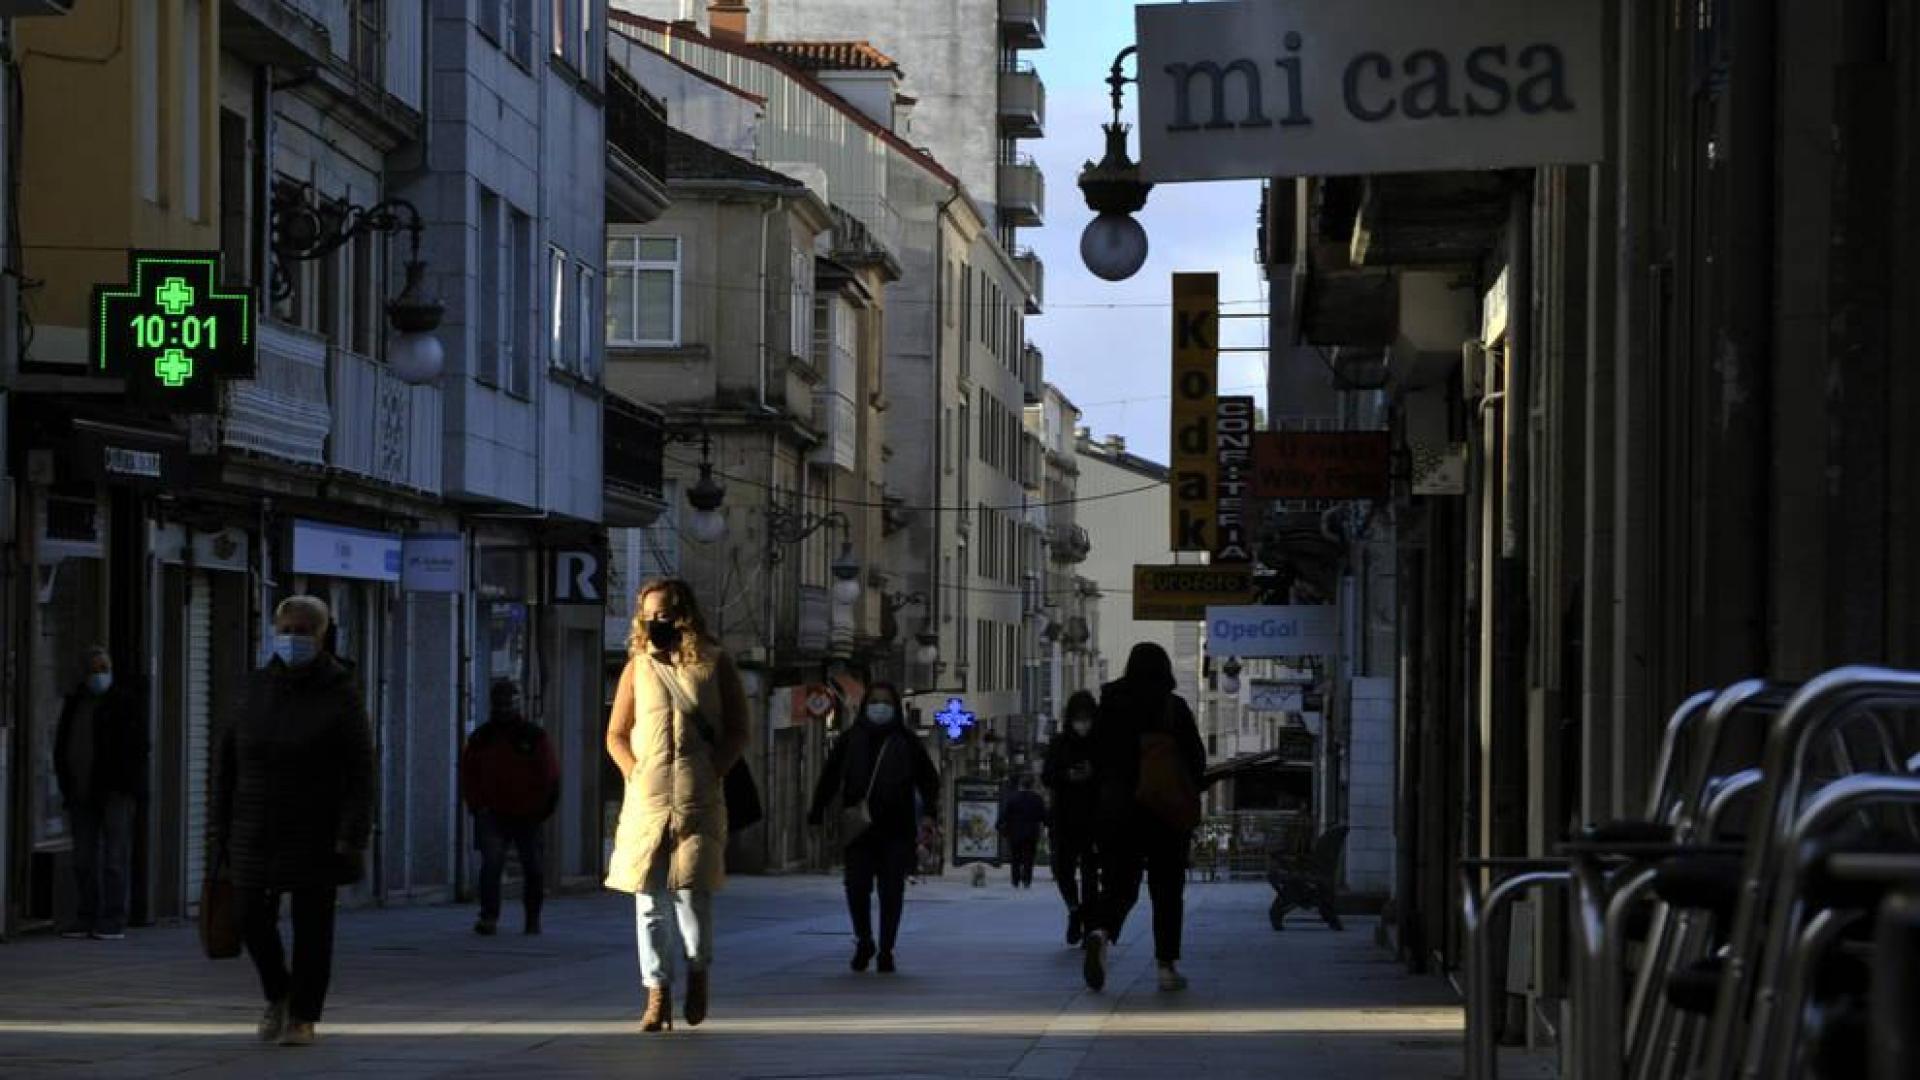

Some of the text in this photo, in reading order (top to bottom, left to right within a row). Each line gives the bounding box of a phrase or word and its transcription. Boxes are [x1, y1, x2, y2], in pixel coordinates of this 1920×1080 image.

[1164, 31, 1576, 132] mi casa
[130, 314, 216, 350] 10:01
[1177, 308, 1214, 550] Kodak
[554, 551, 601, 599] R
